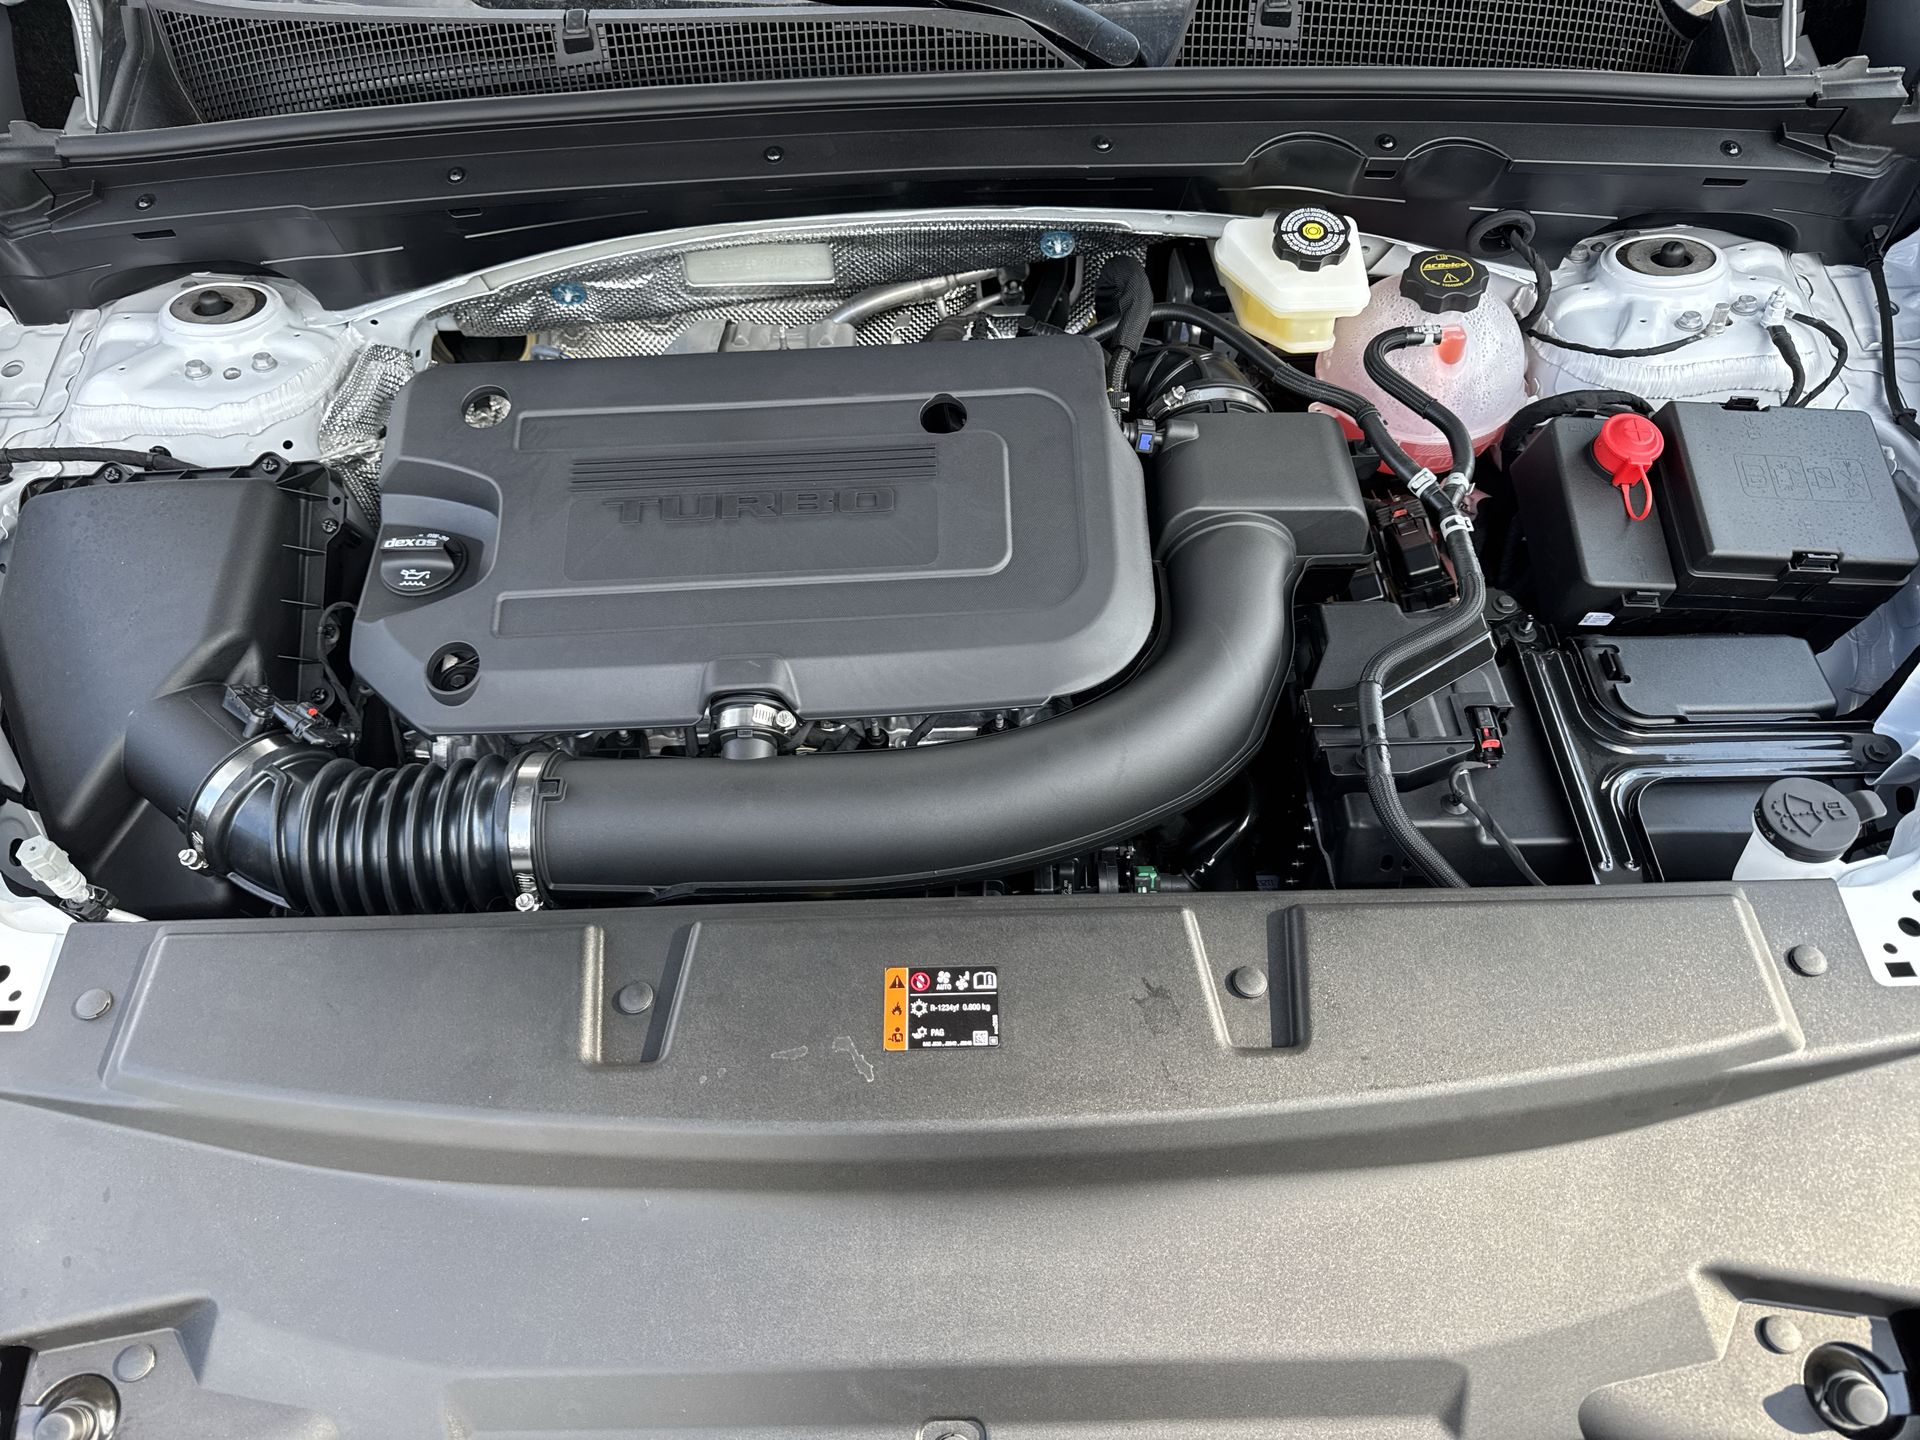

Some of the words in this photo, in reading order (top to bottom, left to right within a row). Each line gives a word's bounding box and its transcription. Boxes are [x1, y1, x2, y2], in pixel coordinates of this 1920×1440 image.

[1423, 262, 1468, 270] ACDelco
[602, 488, 896, 525] TURBO
[384, 538, 438, 548] dexos
[936, 983, 952, 991] AUTO
[930, 1003, 960, 1013] R-1234yf
[982, 1003, 991, 1012] kg
[931, 1028, 945, 1037] PAG
